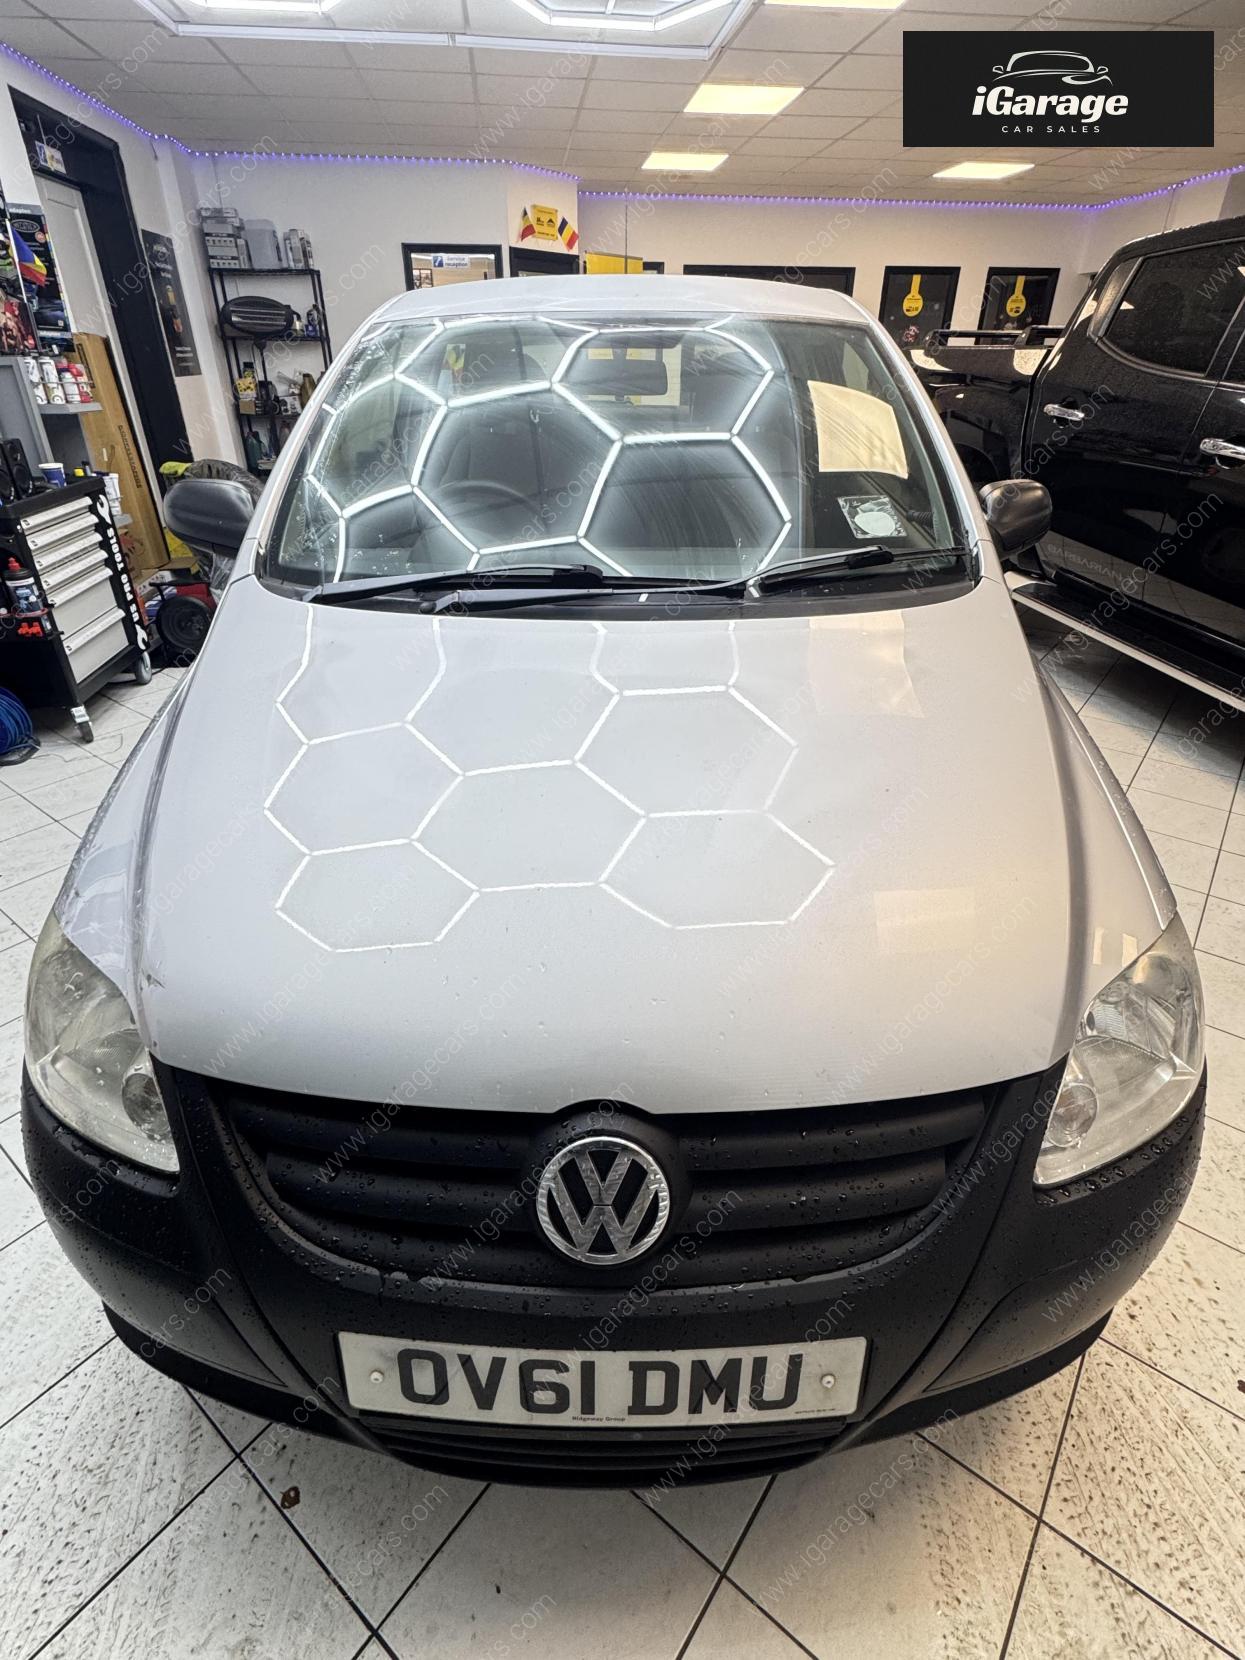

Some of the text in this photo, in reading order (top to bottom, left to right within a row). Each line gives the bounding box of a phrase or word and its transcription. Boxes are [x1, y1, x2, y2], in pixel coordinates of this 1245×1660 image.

[107, 528, 124, 571] TOOLS
[120, 573, 134, 601] PRO
[398, 1348, 804, 1416] OV61 DMU
